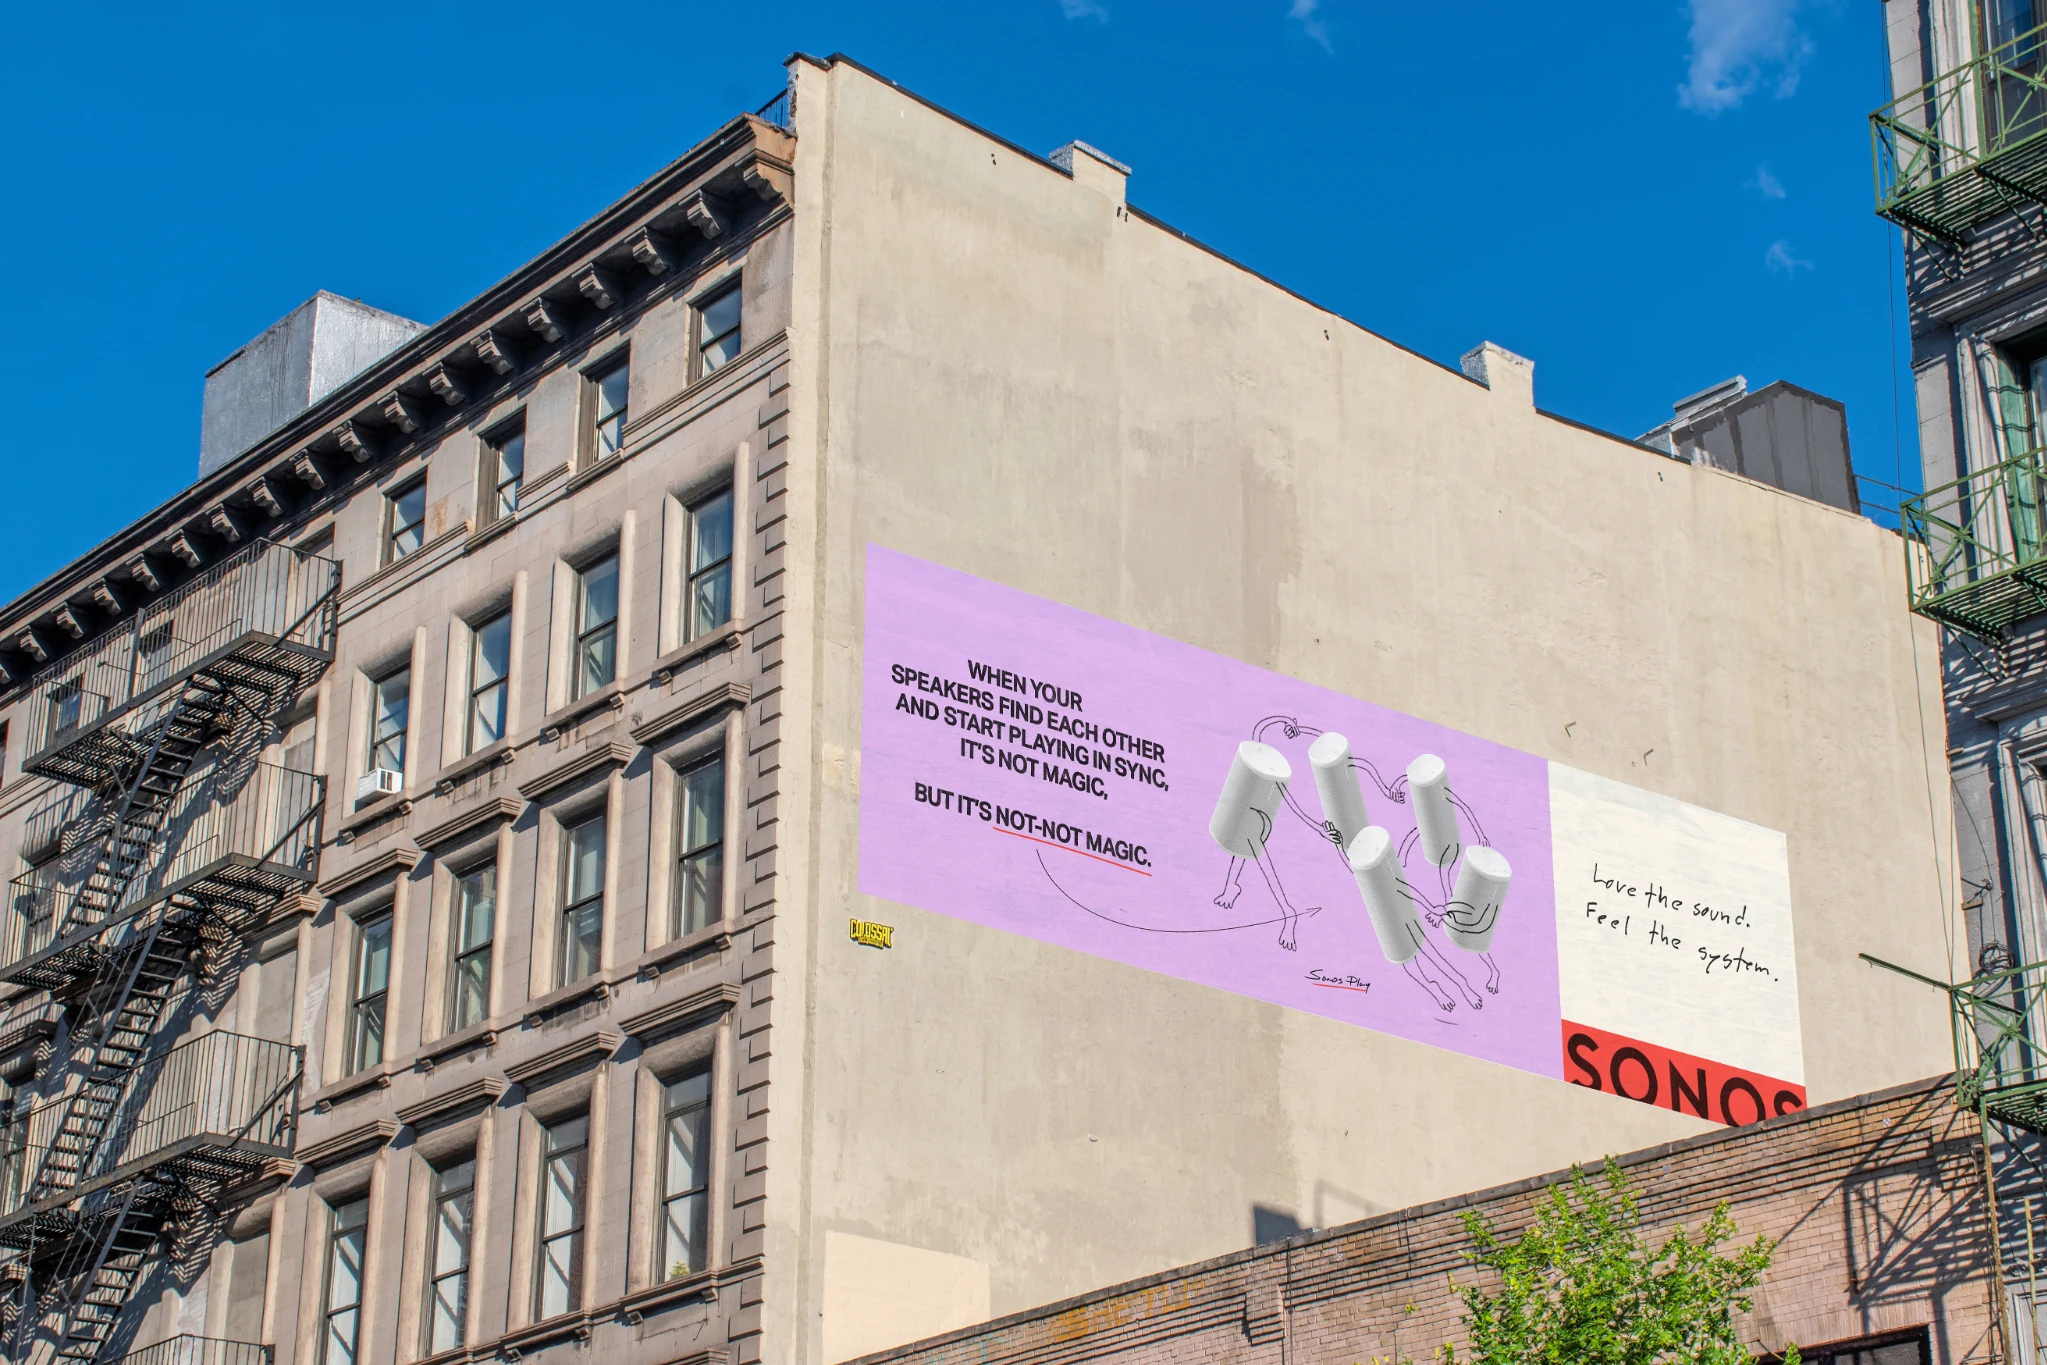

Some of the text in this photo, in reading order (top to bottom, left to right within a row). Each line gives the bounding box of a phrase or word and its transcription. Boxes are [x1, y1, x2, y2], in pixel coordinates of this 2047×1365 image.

[891, 664, 1165, 763] SPEAKERS FIND EACH OTHER
[967, 659, 1083, 712] WHEN YOUR
[896, 693, 1169, 792] AND START PLAYING IN SYNC,
[961, 738, 1108, 801] IT'S NOT MAGIC,
[915, 782, 1152, 868] BUT IT'S NOT-NOT MAGIC.
[1594, 863, 1750, 928] Love the sound.
[850, 918, 891, 947] COLOSSAL
[1587, 902, 1779, 982] Feel the system.
[1304, 969, 1370, 993] Sonos Play
